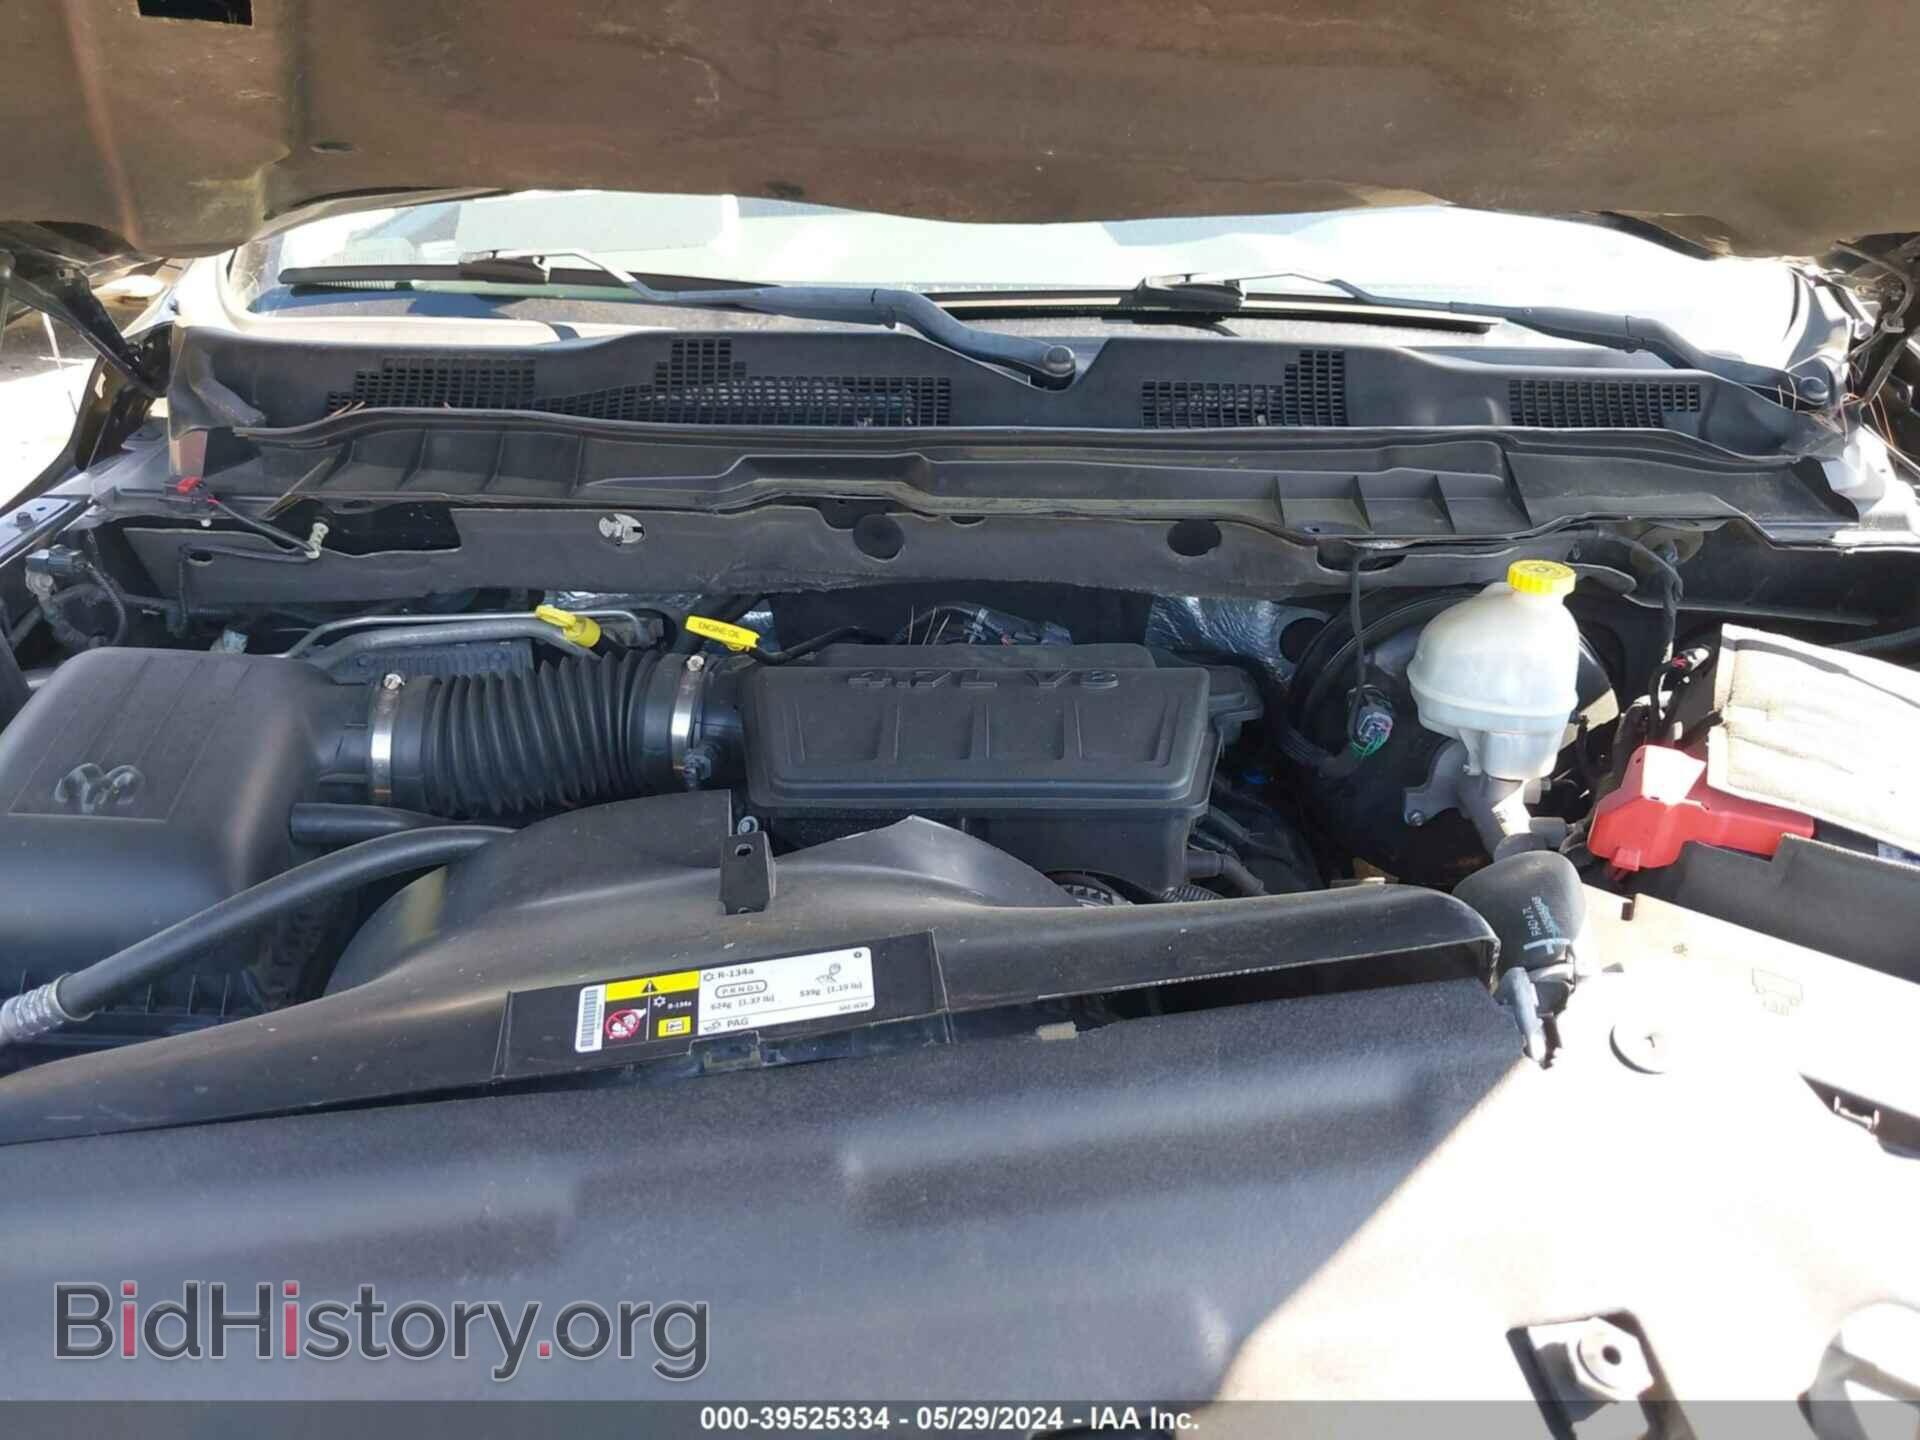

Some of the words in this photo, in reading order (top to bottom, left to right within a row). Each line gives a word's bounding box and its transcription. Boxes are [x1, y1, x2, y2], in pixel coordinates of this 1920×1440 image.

[847, 669, 998, 689] 4.7L
[1026, 669, 1121, 690] V8
[717, 967, 755, 979] R-134a
[727, 1016, 749, 1028] PAG
